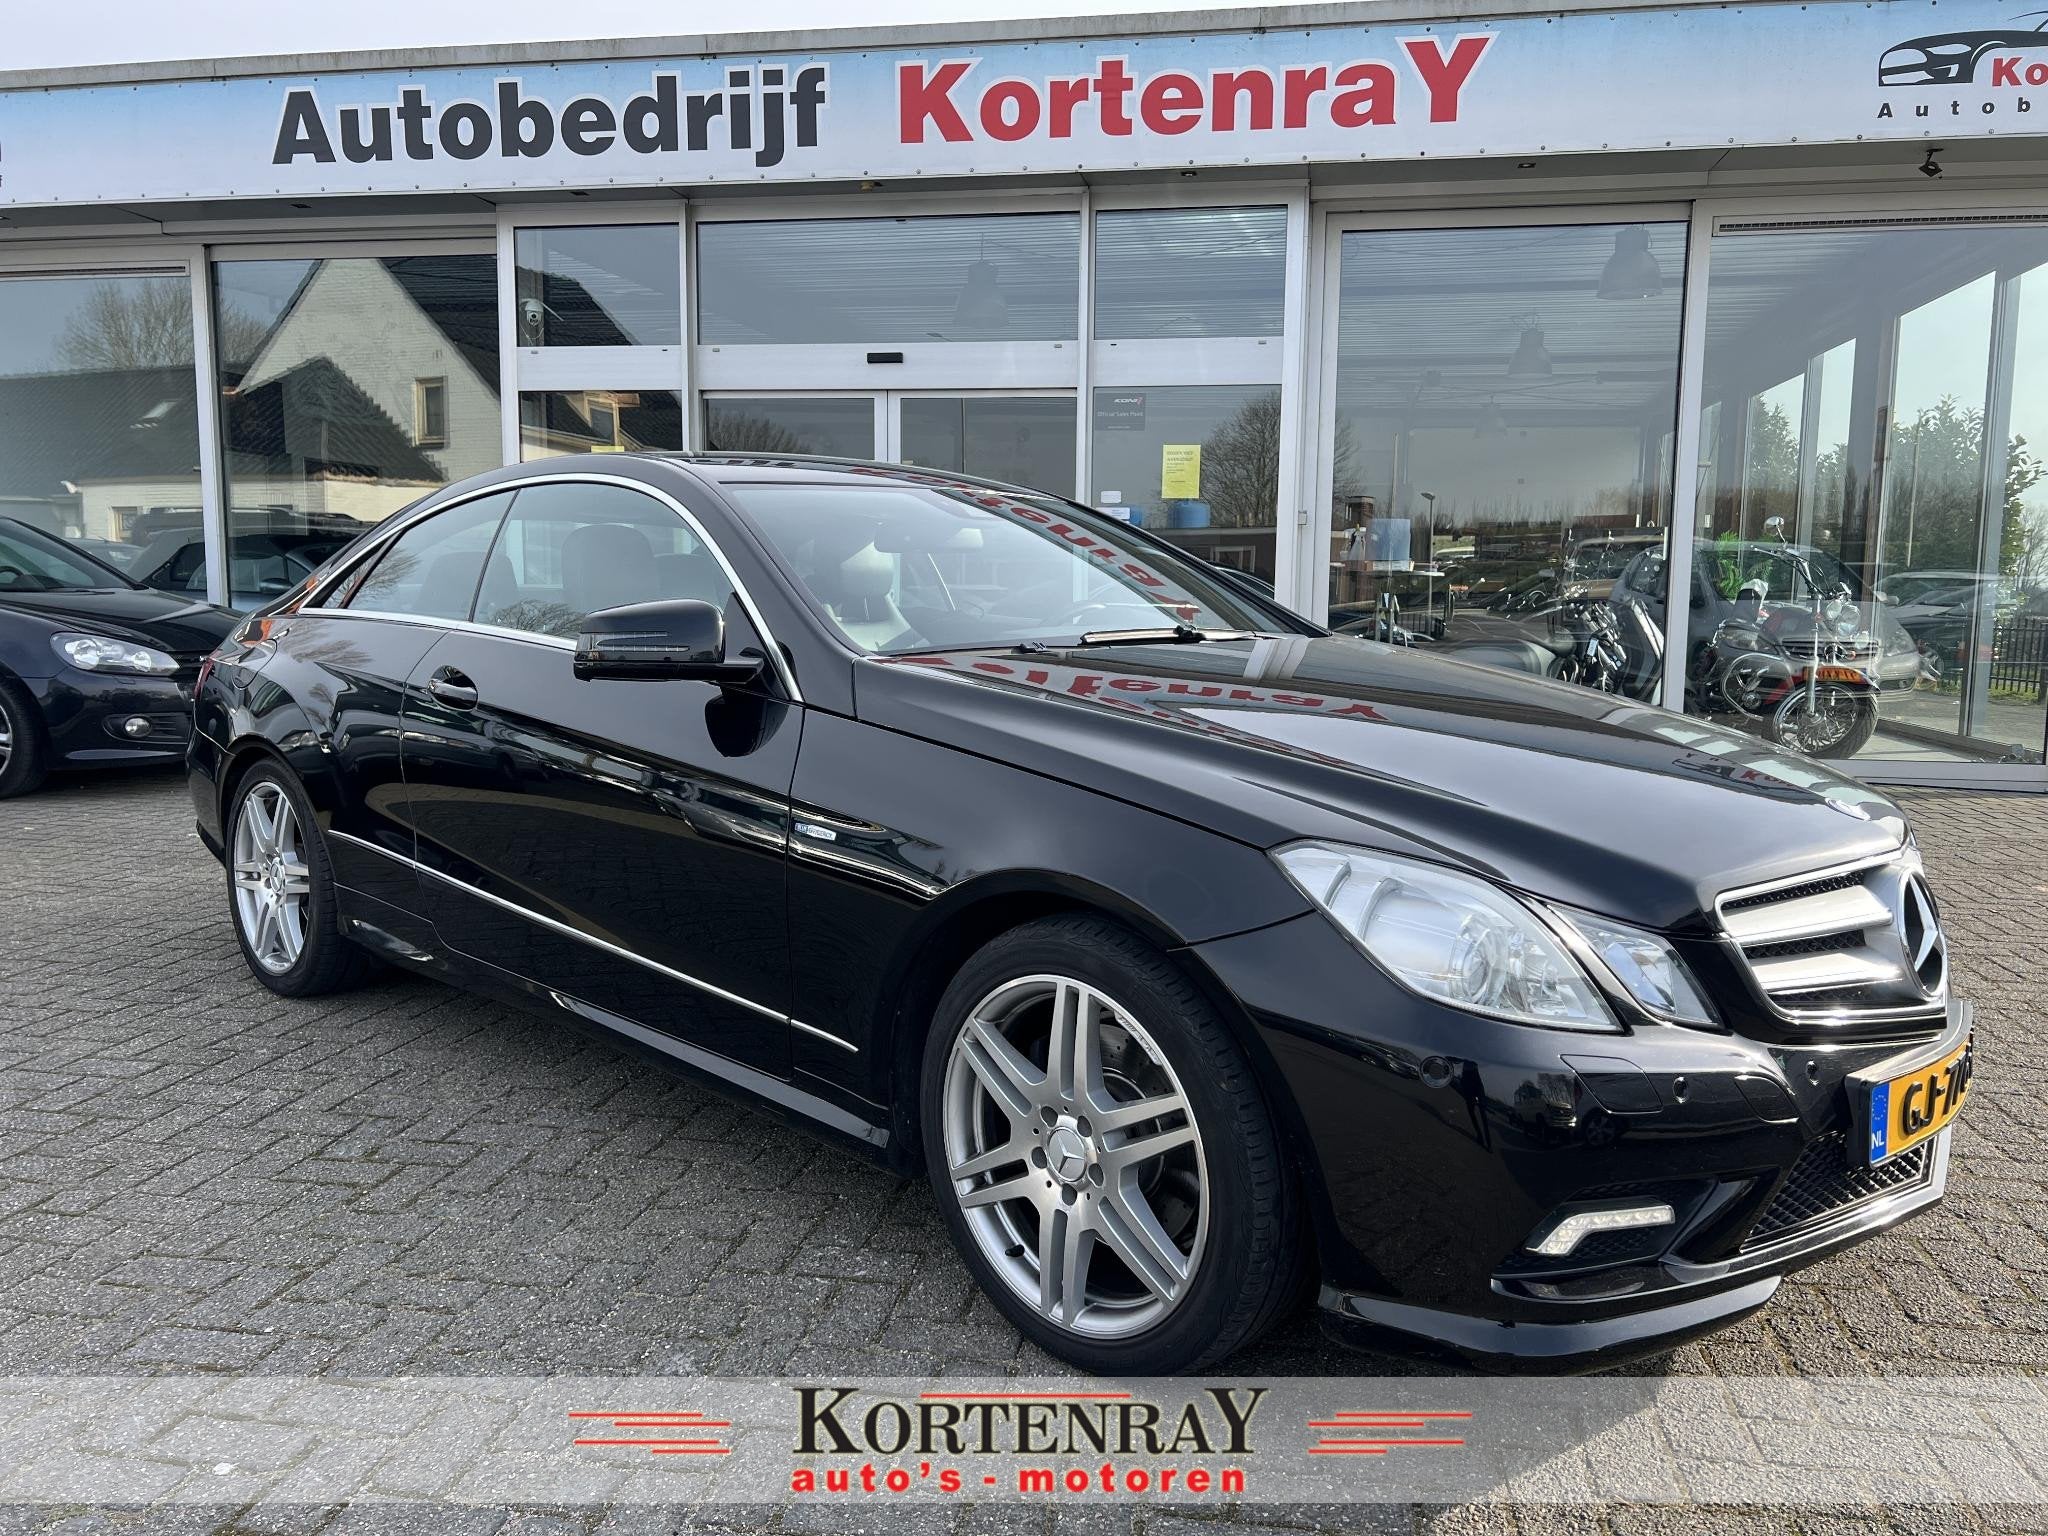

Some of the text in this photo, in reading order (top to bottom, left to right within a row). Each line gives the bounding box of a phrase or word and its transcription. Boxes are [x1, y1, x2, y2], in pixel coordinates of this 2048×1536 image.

[272, 37, 1491, 168] Autobedrijf KortenraY
[1871, 1130, 1885, 1150] NL
